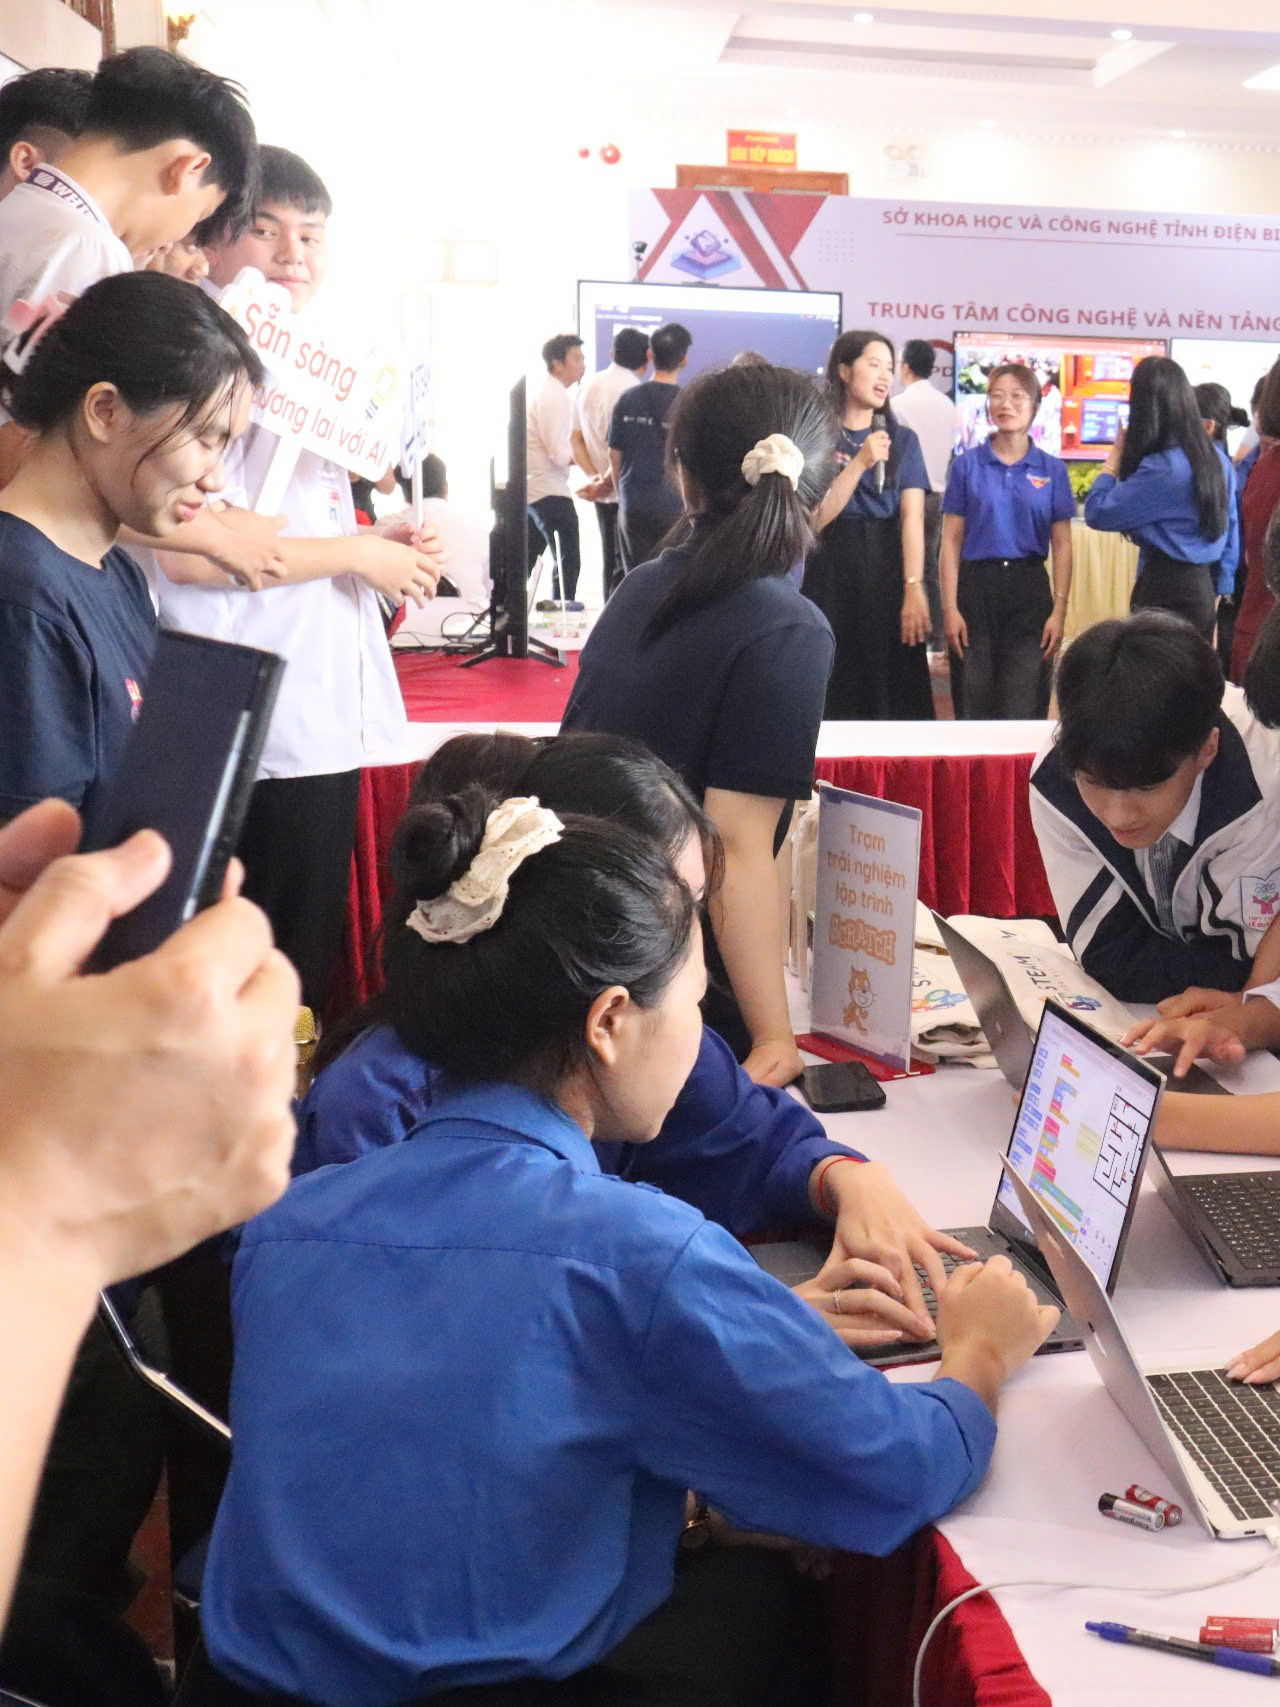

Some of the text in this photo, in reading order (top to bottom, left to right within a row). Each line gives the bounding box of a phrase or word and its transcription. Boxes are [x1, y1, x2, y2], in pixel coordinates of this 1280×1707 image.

[882, 207, 909, 225] SỞ
[914, 212, 968, 228] KHOA
[974, 214, 1013, 232] HỌC
[1019, 214, 1043, 230] VÀ
[1049, 214, 1101, 233] CÔNG
[1107, 219, 1158, 239] NGHỆ
[1213, 223, 1256, 243] ĐIỆN
[868, 302, 945, 320] TRUNG
[953, 301, 999, 321] TÂM
[1006, 303, 1070, 324] CÔNG
[1077, 307, 1137, 330] NGHỆ
[1144, 308, 1172, 328] VÀ
[1178, 307, 1223, 329] NỀN
[245, 303, 291, 359] Sẵn
[295, 340, 357, 402] sàng
[254, 384, 309, 434] ương
[310, 407, 335, 440] lai
[367, 438, 388, 466] AI
[849, 824, 885, 853] Trạm
[826, 849, 906, 889] trải nghiệm
[835, 880, 893, 916] lập trình
